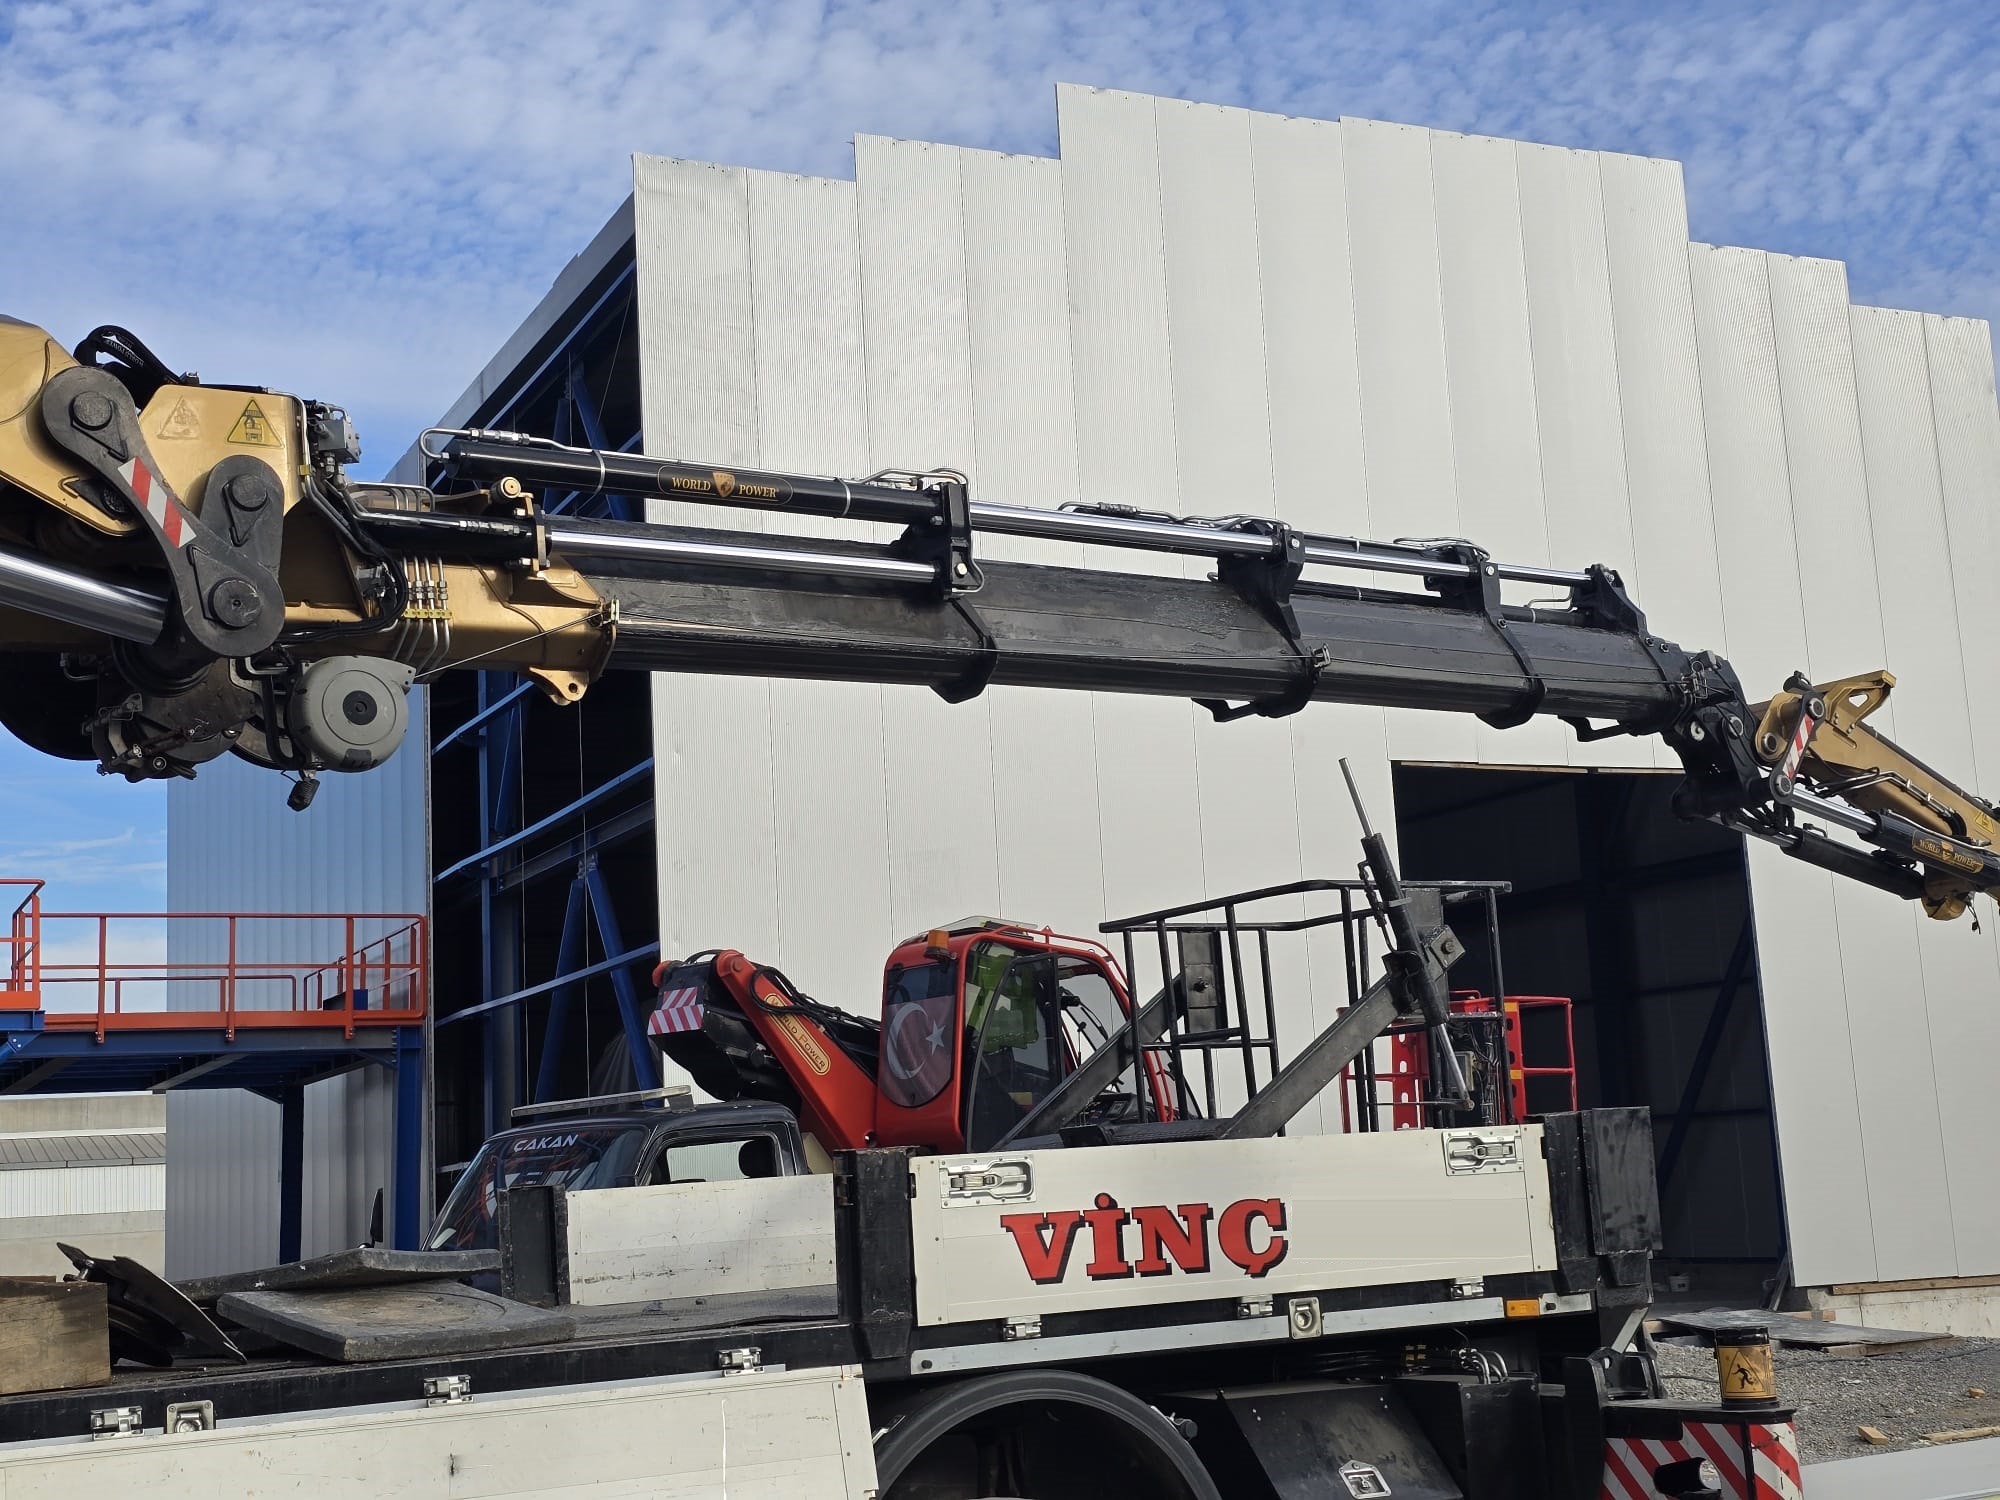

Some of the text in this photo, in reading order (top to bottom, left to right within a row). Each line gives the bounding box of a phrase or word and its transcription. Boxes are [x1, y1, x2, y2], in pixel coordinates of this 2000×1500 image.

[672, 477, 777, 498] WORLD POWER
[771, 998, 826, 1069] WRLD POWER
[1000, 1192, 1288, 1285] VİNÇ
